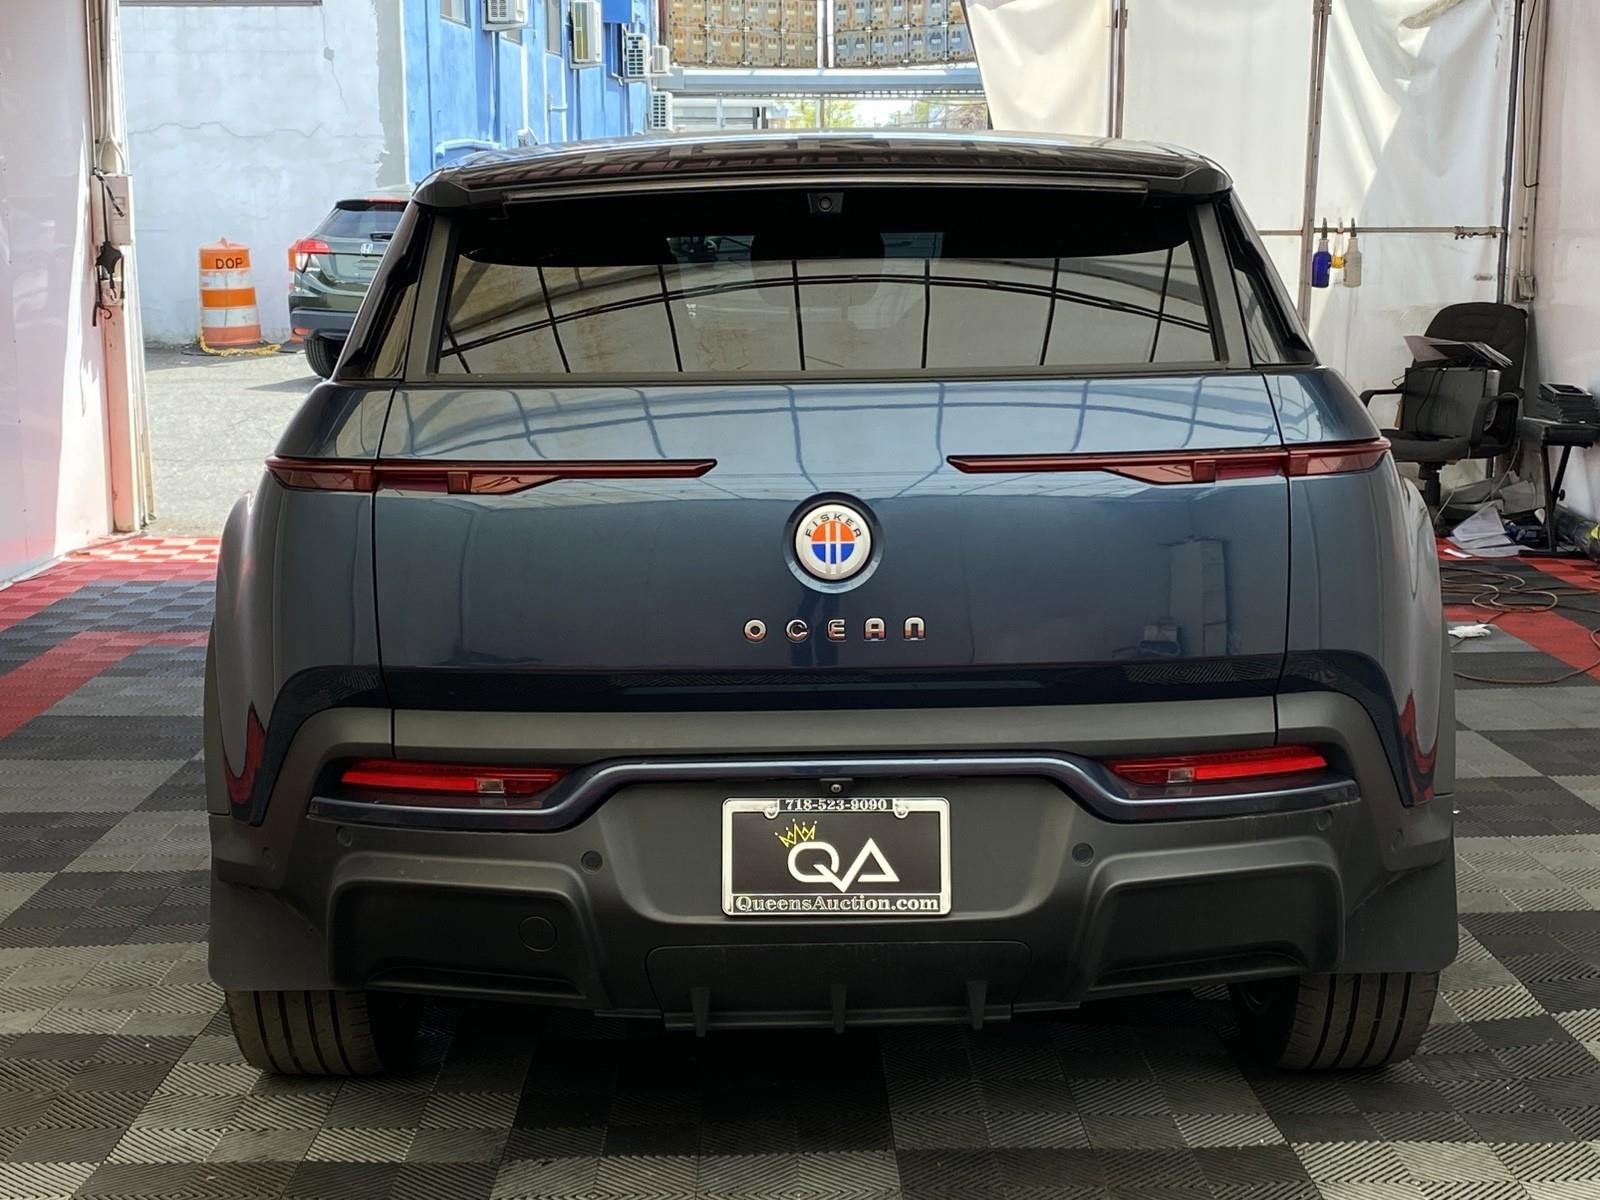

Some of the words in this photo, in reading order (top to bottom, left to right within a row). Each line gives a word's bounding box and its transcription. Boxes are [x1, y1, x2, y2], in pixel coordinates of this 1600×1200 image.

[805, 512, 862, 538] FISKER
[743, 616, 927, 642] OCEAN
[785, 799, 888, 811] 718-523-9090
[787, 837, 900, 893] QA
[735, 894, 939, 913] QueensAuction.com
